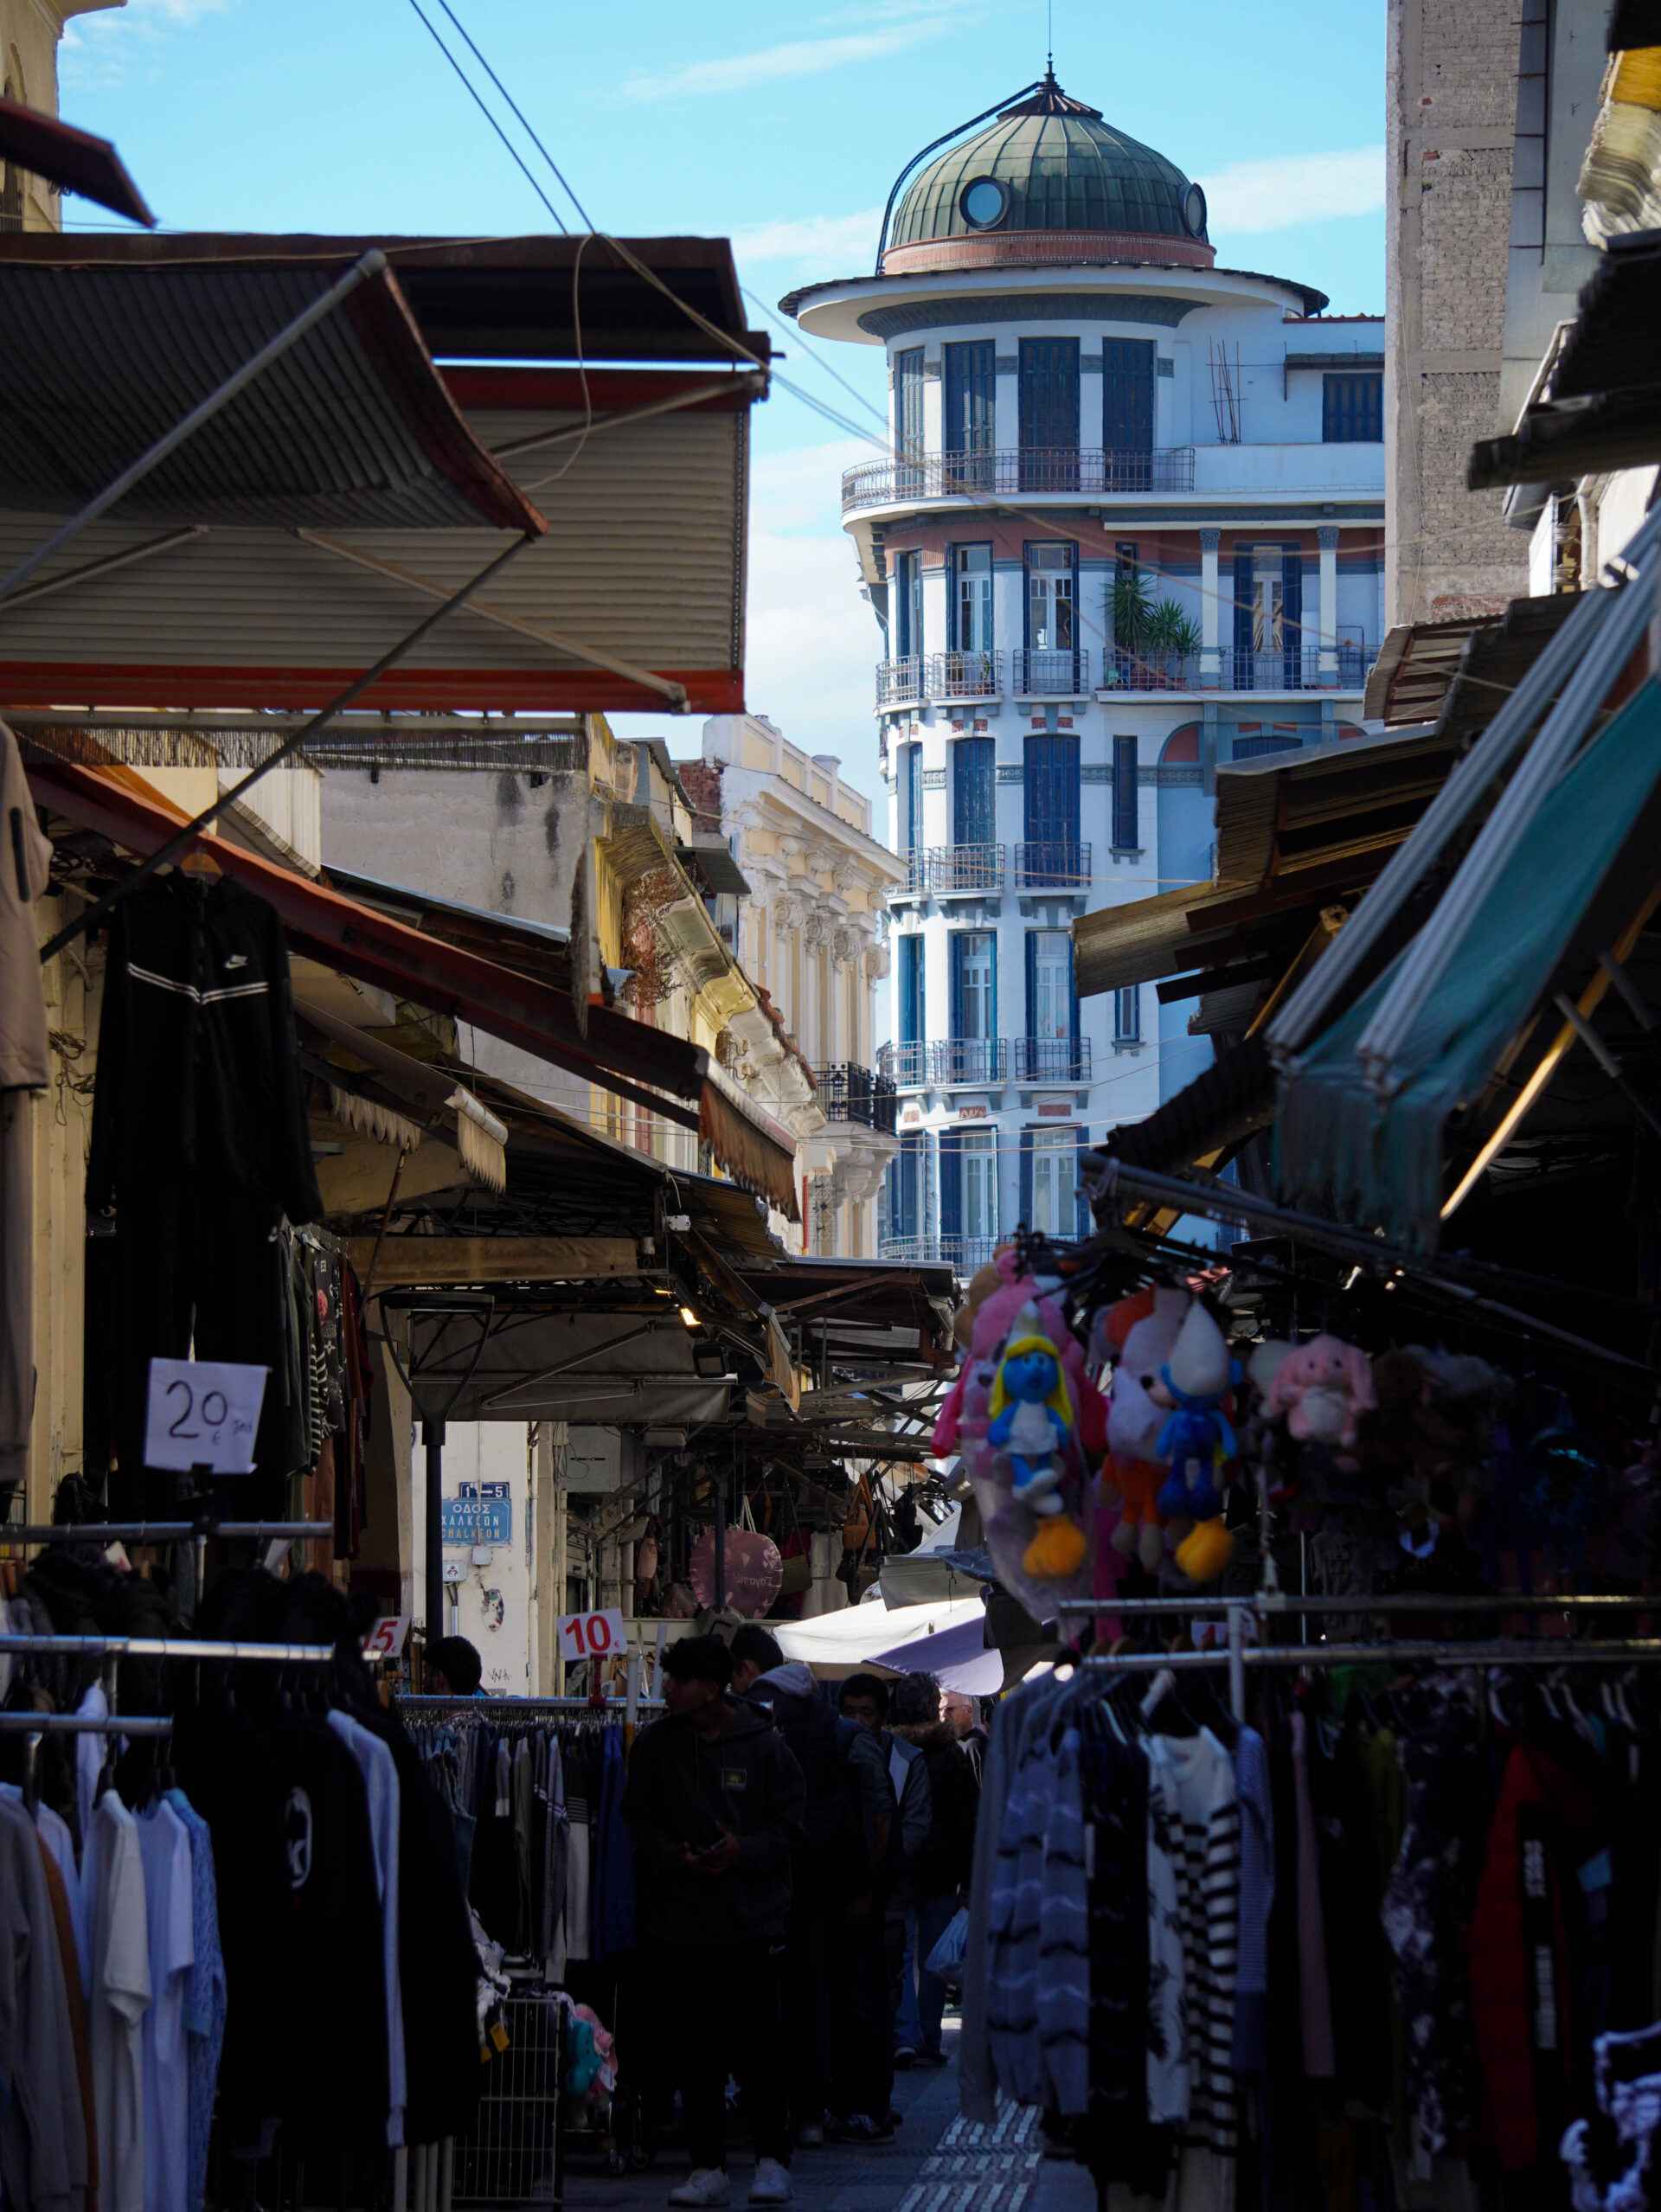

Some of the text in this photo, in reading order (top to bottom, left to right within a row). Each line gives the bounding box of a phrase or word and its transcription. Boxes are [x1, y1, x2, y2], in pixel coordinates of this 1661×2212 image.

[166, 1380, 228, 1439] 20
[452, 1504, 491, 1515] ΟΔΟΣ
[565, 1614, 611, 1655] 10
